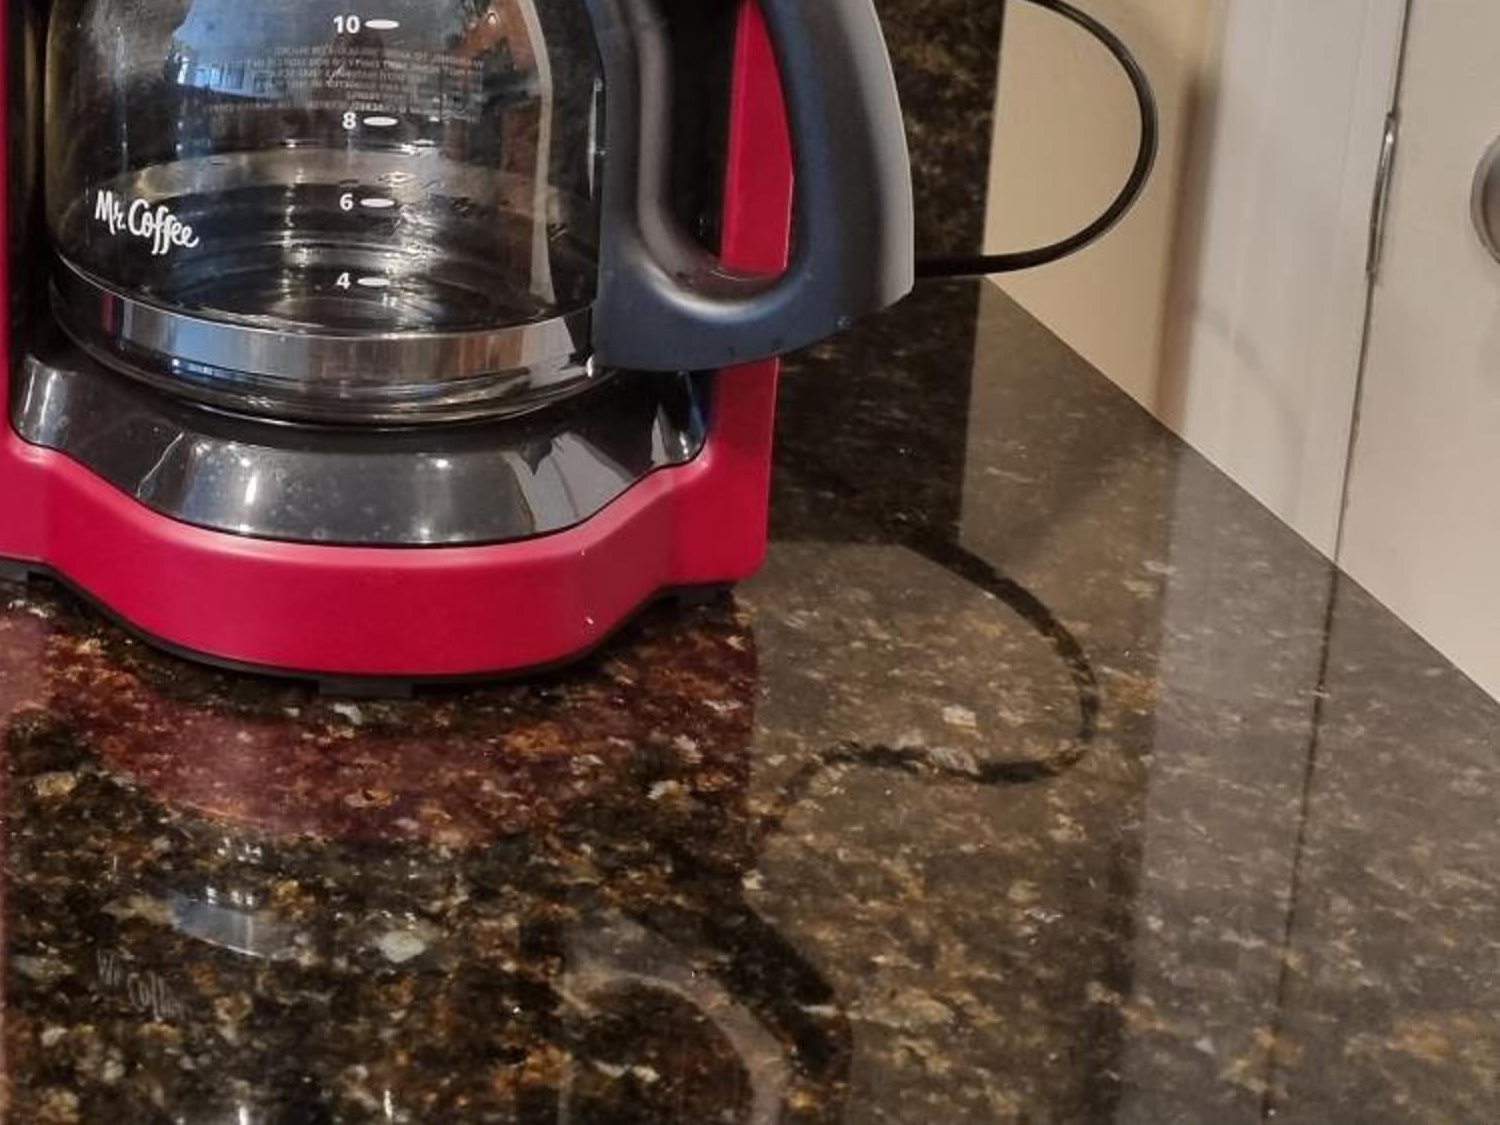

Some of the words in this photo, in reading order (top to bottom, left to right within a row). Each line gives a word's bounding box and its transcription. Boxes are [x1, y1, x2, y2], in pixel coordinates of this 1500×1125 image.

[333, 15, 361, 34] 10
[342, 111, 357, 130] 8
[339, 193, 354, 211] 6
[95, 190, 127, 235] Mr.
[128, 198, 200, 255] Coffee
[336, 272, 351, 289] 4
